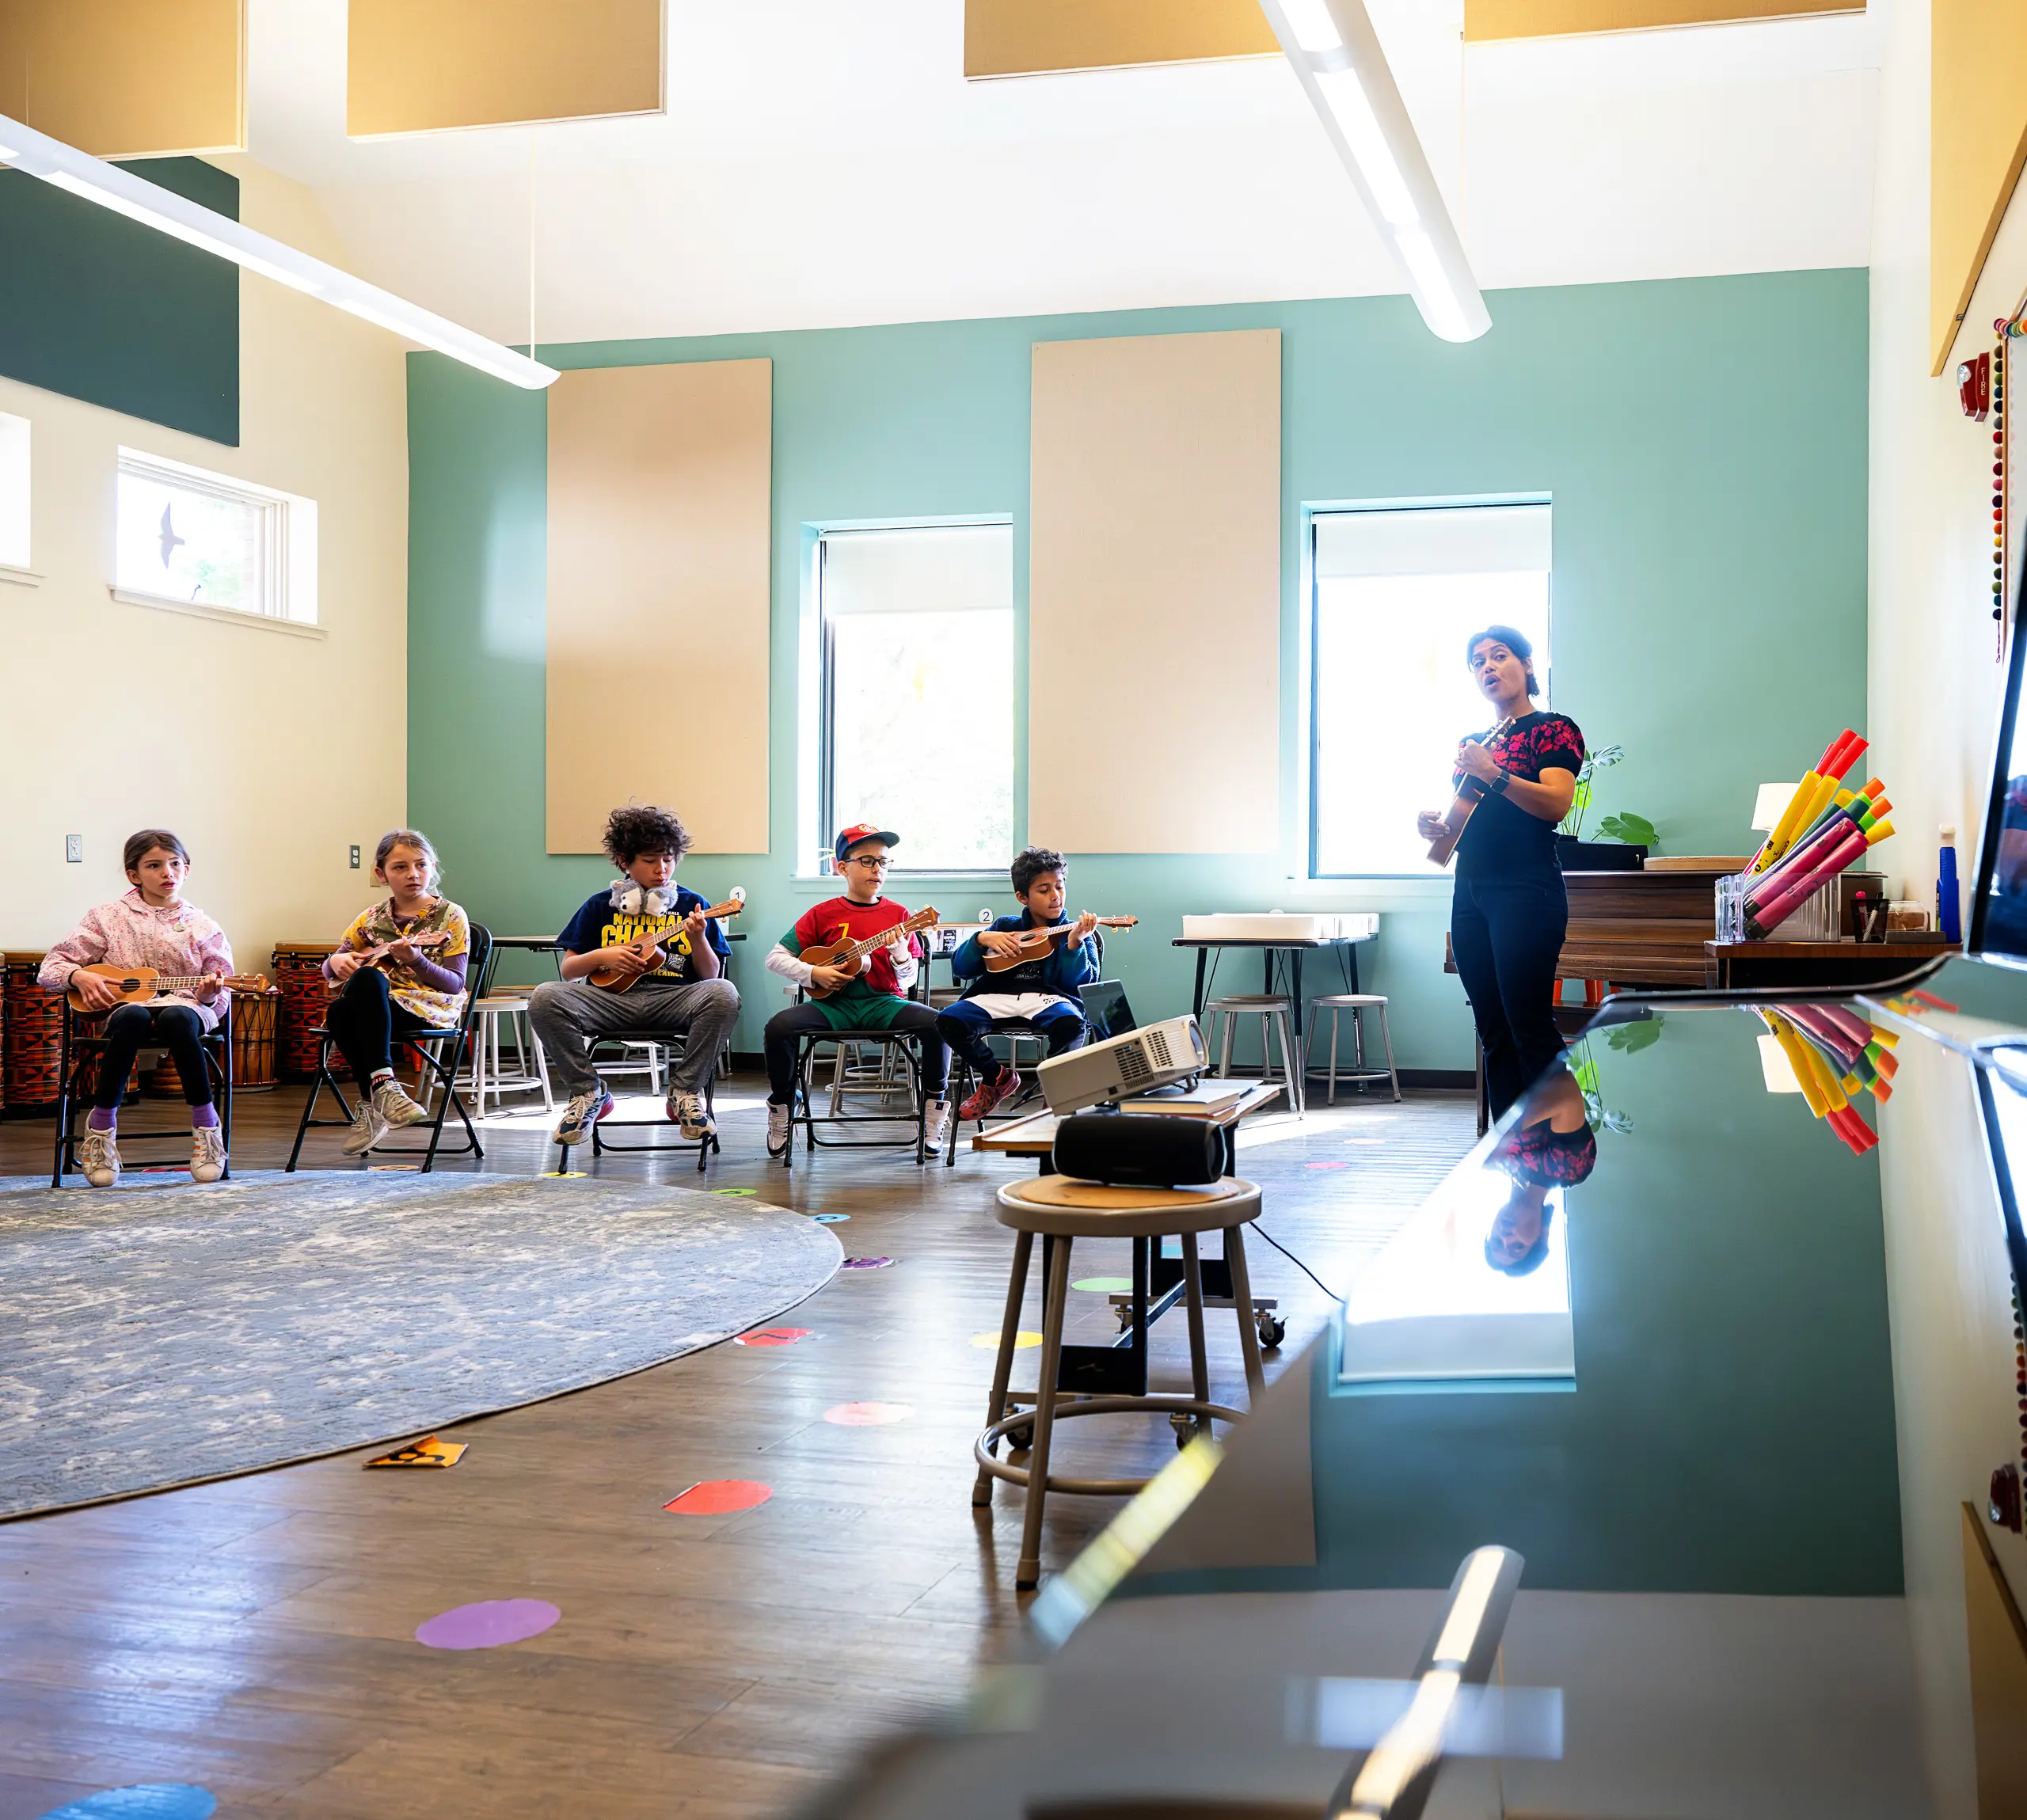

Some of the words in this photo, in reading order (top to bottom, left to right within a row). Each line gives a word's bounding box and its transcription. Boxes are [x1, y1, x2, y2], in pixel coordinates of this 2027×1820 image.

[613, 913, 683, 926] NATIONAL
[983, 911, 990, 921] 2
[839, 923, 849, 938] 7
